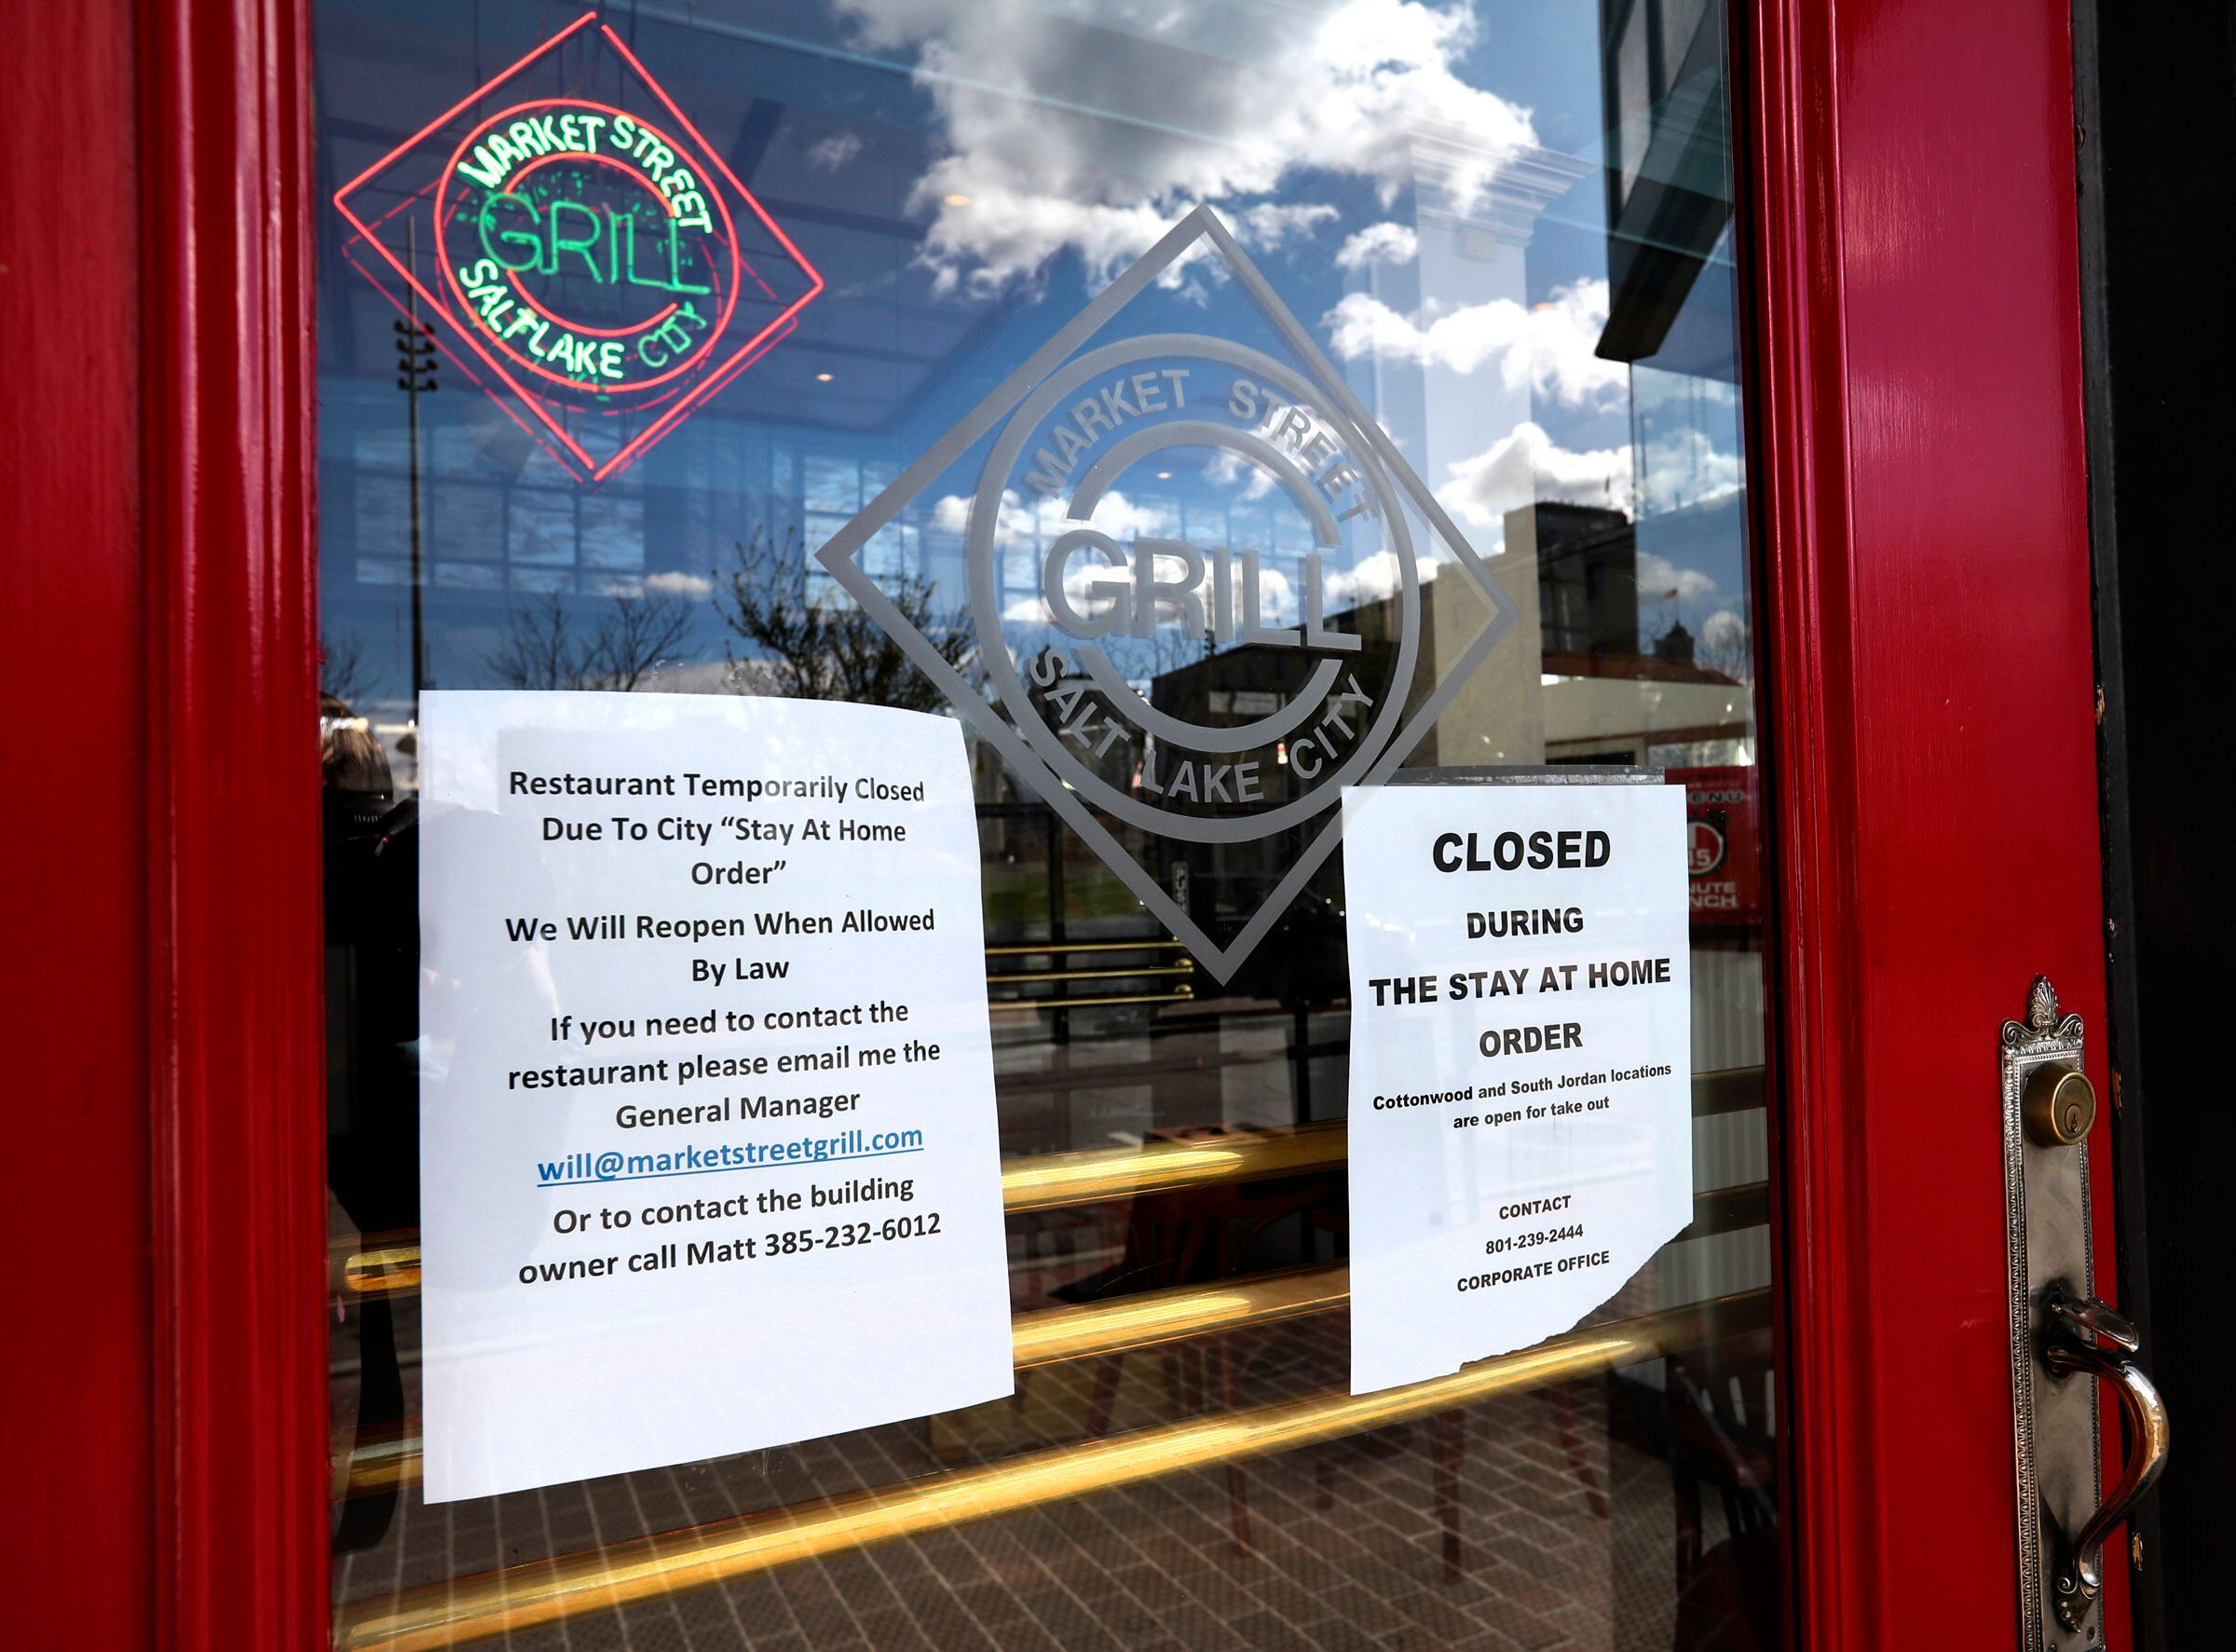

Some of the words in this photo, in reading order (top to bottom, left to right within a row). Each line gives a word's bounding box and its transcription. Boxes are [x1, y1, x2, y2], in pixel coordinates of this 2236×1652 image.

[457, 114, 606, 189] MARKET
[609, 116, 714, 234] STREET
[479, 193, 711, 294] GRILL
[459, 258, 539, 338] SALT
[528, 321, 625, 379] LAKE
[637, 301, 707, 367] CITY
[1030, 369, 1190, 499] MARKET
[1229, 378, 1378, 524] STREET
[1044, 528, 1362, 651] GRILL
[1029, 650, 1131, 759] SALT
[1142, 749, 1265, 803] LAKE
[1289, 673, 1375, 780] CITY
[511, 771, 675, 796] Restaurant
[683, 773, 848, 803] Temporarily
[855, 777, 924, 801] Closed
[543, 817, 602, 840] Due
[611, 817, 648, 840] To
[658, 817, 713, 846] City
[721, 816, 794, 846] “Stay
[802, 819, 830, 840] At
[839, 819, 906, 841] Home
[1433, 831, 1610, 873] CLOSED
[691, 860, 786, 885] Order”
[505, 918, 557, 941] We
[566, 915, 625, 940] Will
[637, 916, 744, 943] Reopen
[754, 911, 832, 935] When
[841, 908, 934, 933] Allowed
[1466, 907, 1583, 939] DURING
[692, 959, 727, 987] By
[736, 958, 789, 980] Law
[1369, 976, 1438, 1006] THE
[1449, 968, 1529, 1000] STAY
[1539, 965, 1577, 992] AT
[1588, 958, 1670, 989] HOME
[552, 1016, 572, 1041] If
[579, 1020, 634, 1045] you
[647, 1009, 716, 1036] need
[726, 1011, 755, 1031] to
[764, 1004, 862, 1030] contact
[869, 1000, 908, 1023] the
[1479, 1022, 1583, 1058] ORDER
[509, 1059, 668, 1089] restaurant
[678, 1054, 768, 1085] please
[777, 1044, 849, 1072] email
[859, 1048, 896, 1067] me
[903, 1040, 940, 1062] the
[1373, 1086, 1473, 1110] Cottonwood
[1479, 1083, 1506, 1099] and
[1511, 1077, 1553, 1094] South
[1558, 1072, 1606, 1088] Jordan
[1611, 1065, 1671, 1082] locations
[616, 1098, 729, 1128] General
[741, 1094, 860, 1119] Manager
[1453, 1116, 1479, 1128] are
[1484, 1111, 1521, 1126] open
[1526, 1106, 1547, 1119] for
[1550, 1100, 1582, 1115] take
[1588, 1096, 1609, 1111] out
[537, 1129, 924, 1188] will@marketstreetgrill.com
[553, 1209, 592, 1234] Or
[600, 1208, 632, 1229] to
[641, 1195, 748, 1225] contact
[757, 1189, 801, 1213] the
[811, 1178, 913, 1208] building
[1499, 1195, 1571, 1220] CONTACT
[519, 1257, 619, 1284] owner
[628, 1244, 675, 1272] call
[688, 1238, 757, 1265] Matt
[765, 1213, 941, 1256] 385-232-6012
[1486, 1223, 1583, 1254] 801-239-2444
[1457, 1262, 1552, 1291] CORPORATE
[1558, 1250, 1609, 1272] OFFICE
